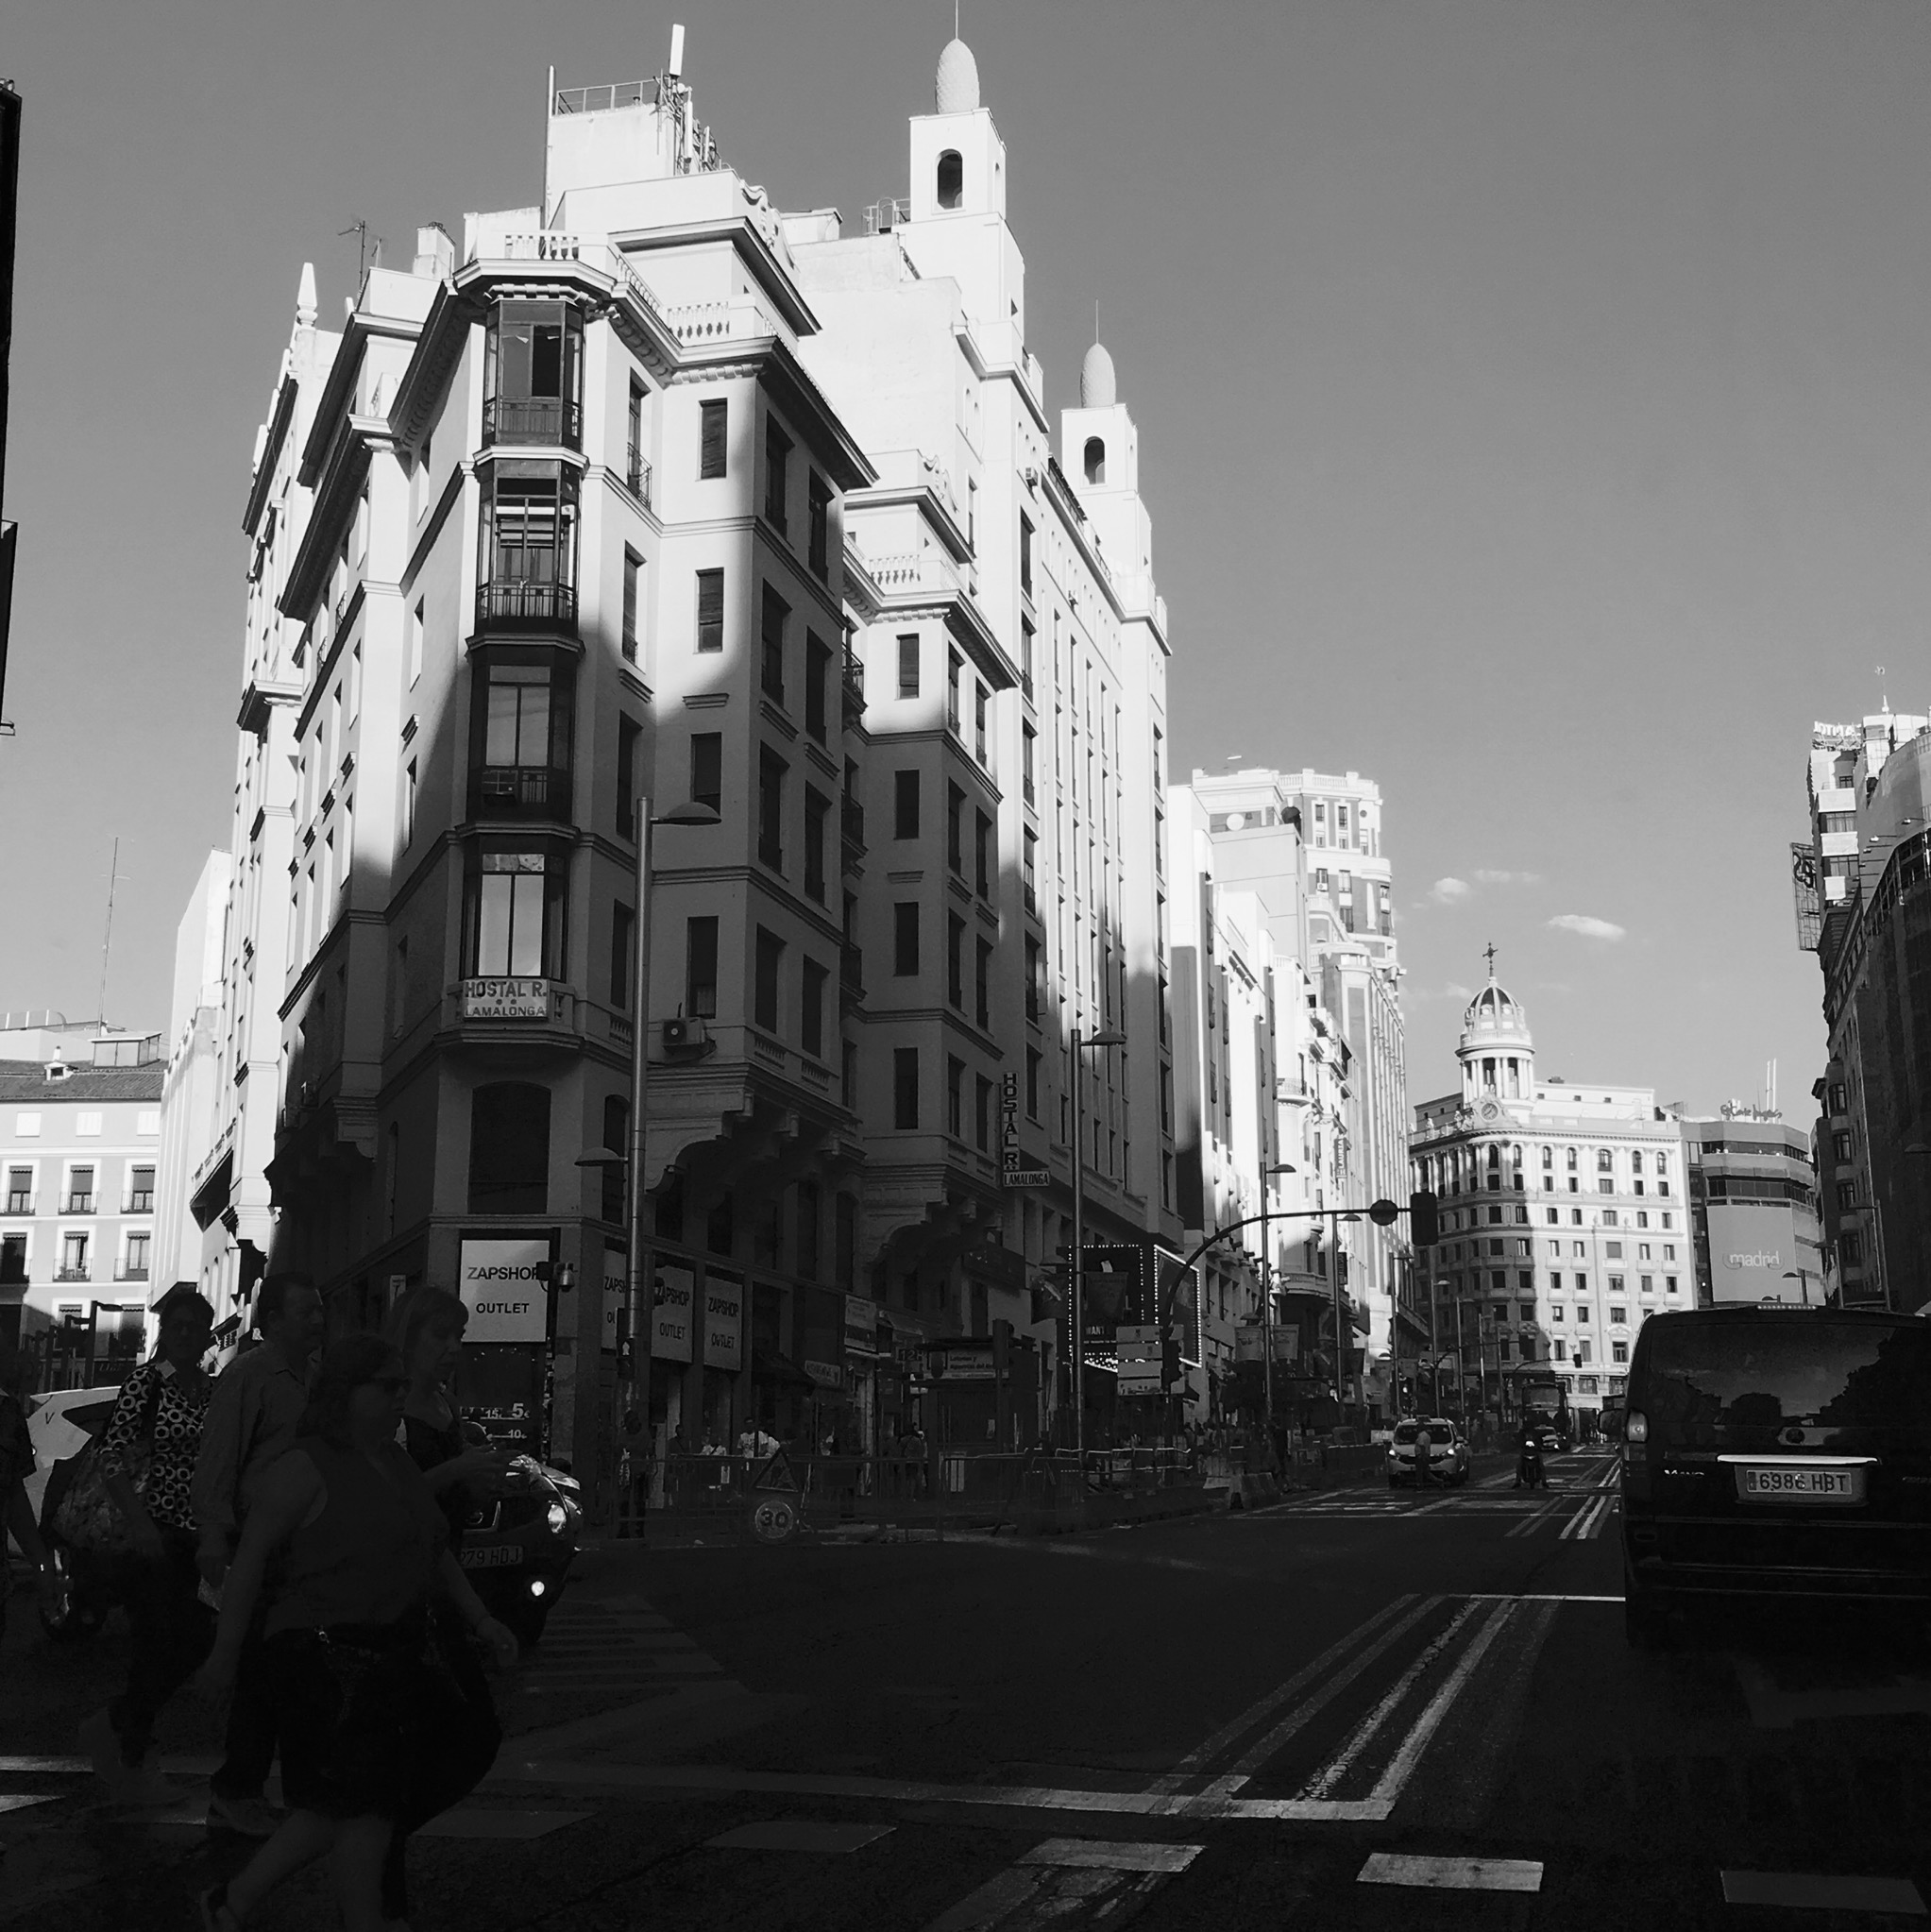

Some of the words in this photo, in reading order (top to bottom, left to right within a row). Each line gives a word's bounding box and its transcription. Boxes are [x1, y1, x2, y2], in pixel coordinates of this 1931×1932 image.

[466, 981, 526, 997] HOSTAL
[532, 982, 547, 997] R.
[466, 1006, 546, 1017] LAMALONGA
[1003, 1073, 1018, 1147] HOSTAL
[1004, 1173, 1049, 1186] LAMALONGA
[1729, 1250, 1780, 1267] madrid
[476, 1303, 530, 1313] OUTLET
[708, 1296, 739, 1318] ZAPSHOP
[659, 1322, 686, 1340] OUTLET
[711, 1332, 735, 1349] OUTLET
[1759, 1473, 1805, 1490] 6986
[1811, 1473, 1846, 1492] HBT
[760, 1510, 788, 1528] 30
